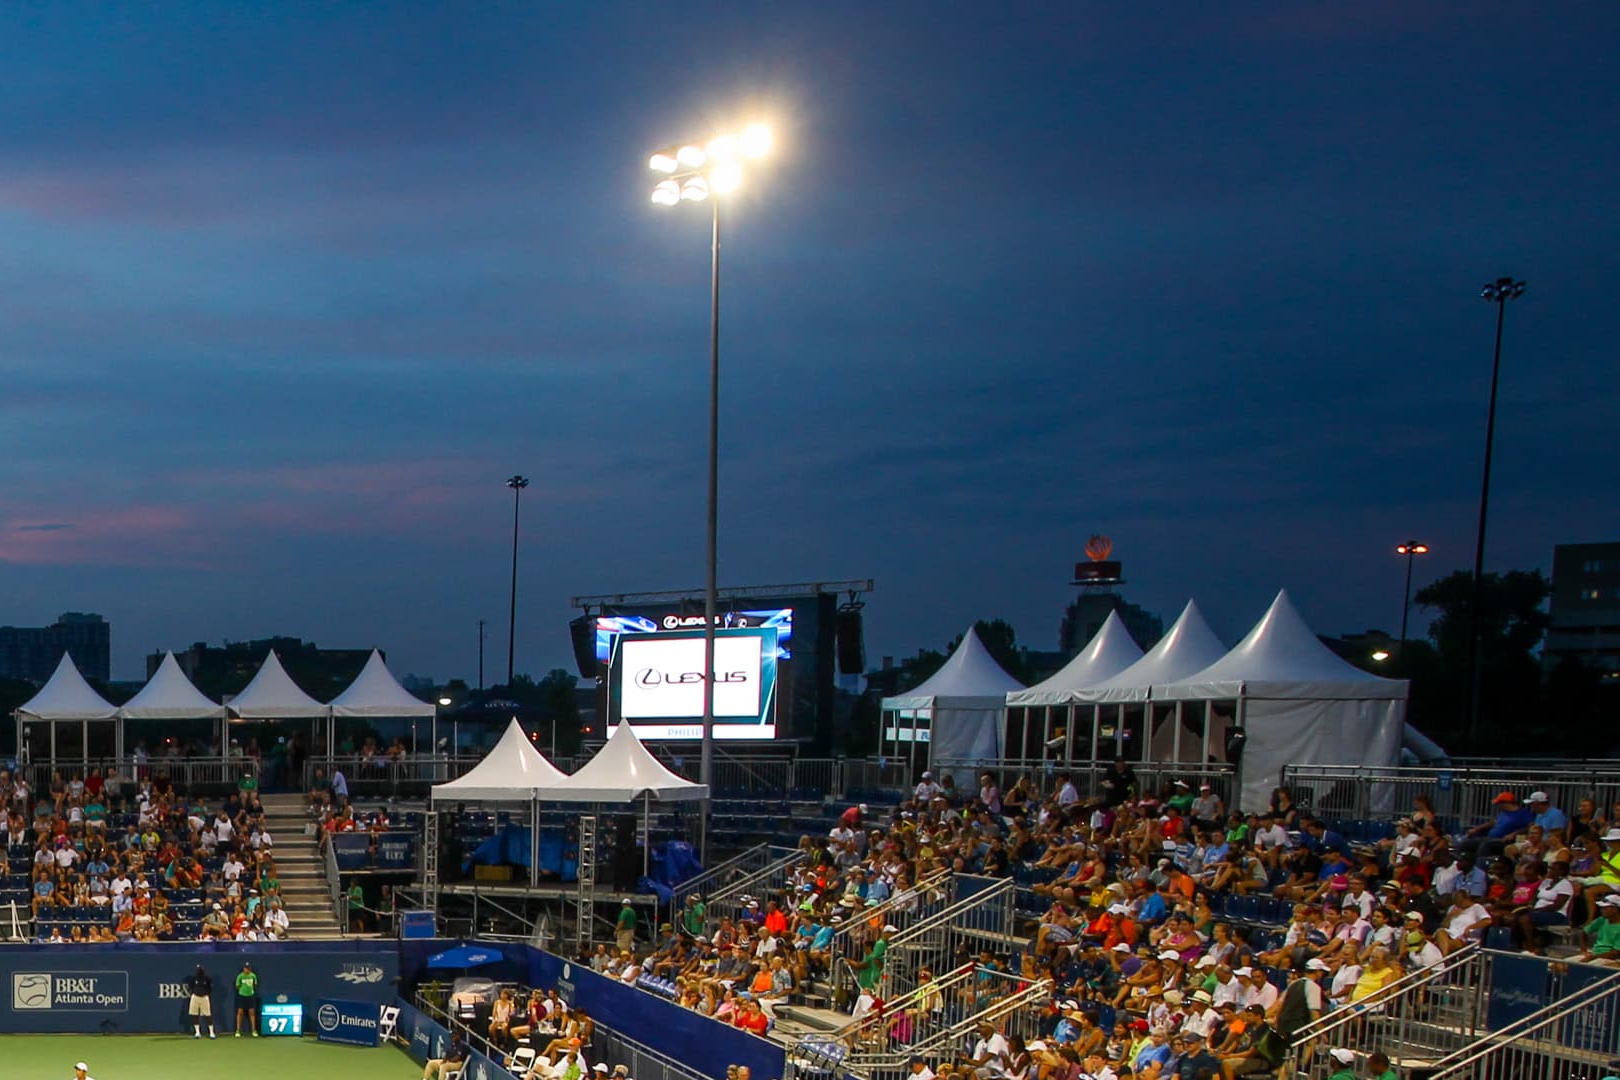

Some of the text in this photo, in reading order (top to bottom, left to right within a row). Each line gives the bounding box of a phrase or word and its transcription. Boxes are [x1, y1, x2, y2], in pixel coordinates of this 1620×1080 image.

[667, 727, 703, 737] PHILIP
[55, 978, 98, 993] BB&T
[159, 983, 191, 999] BB&
[55, 993, 124, 1006] Atlanta Open
[269, 1018, 288, 1033] 97
[341, 1014, 376, 1028] Emirates
